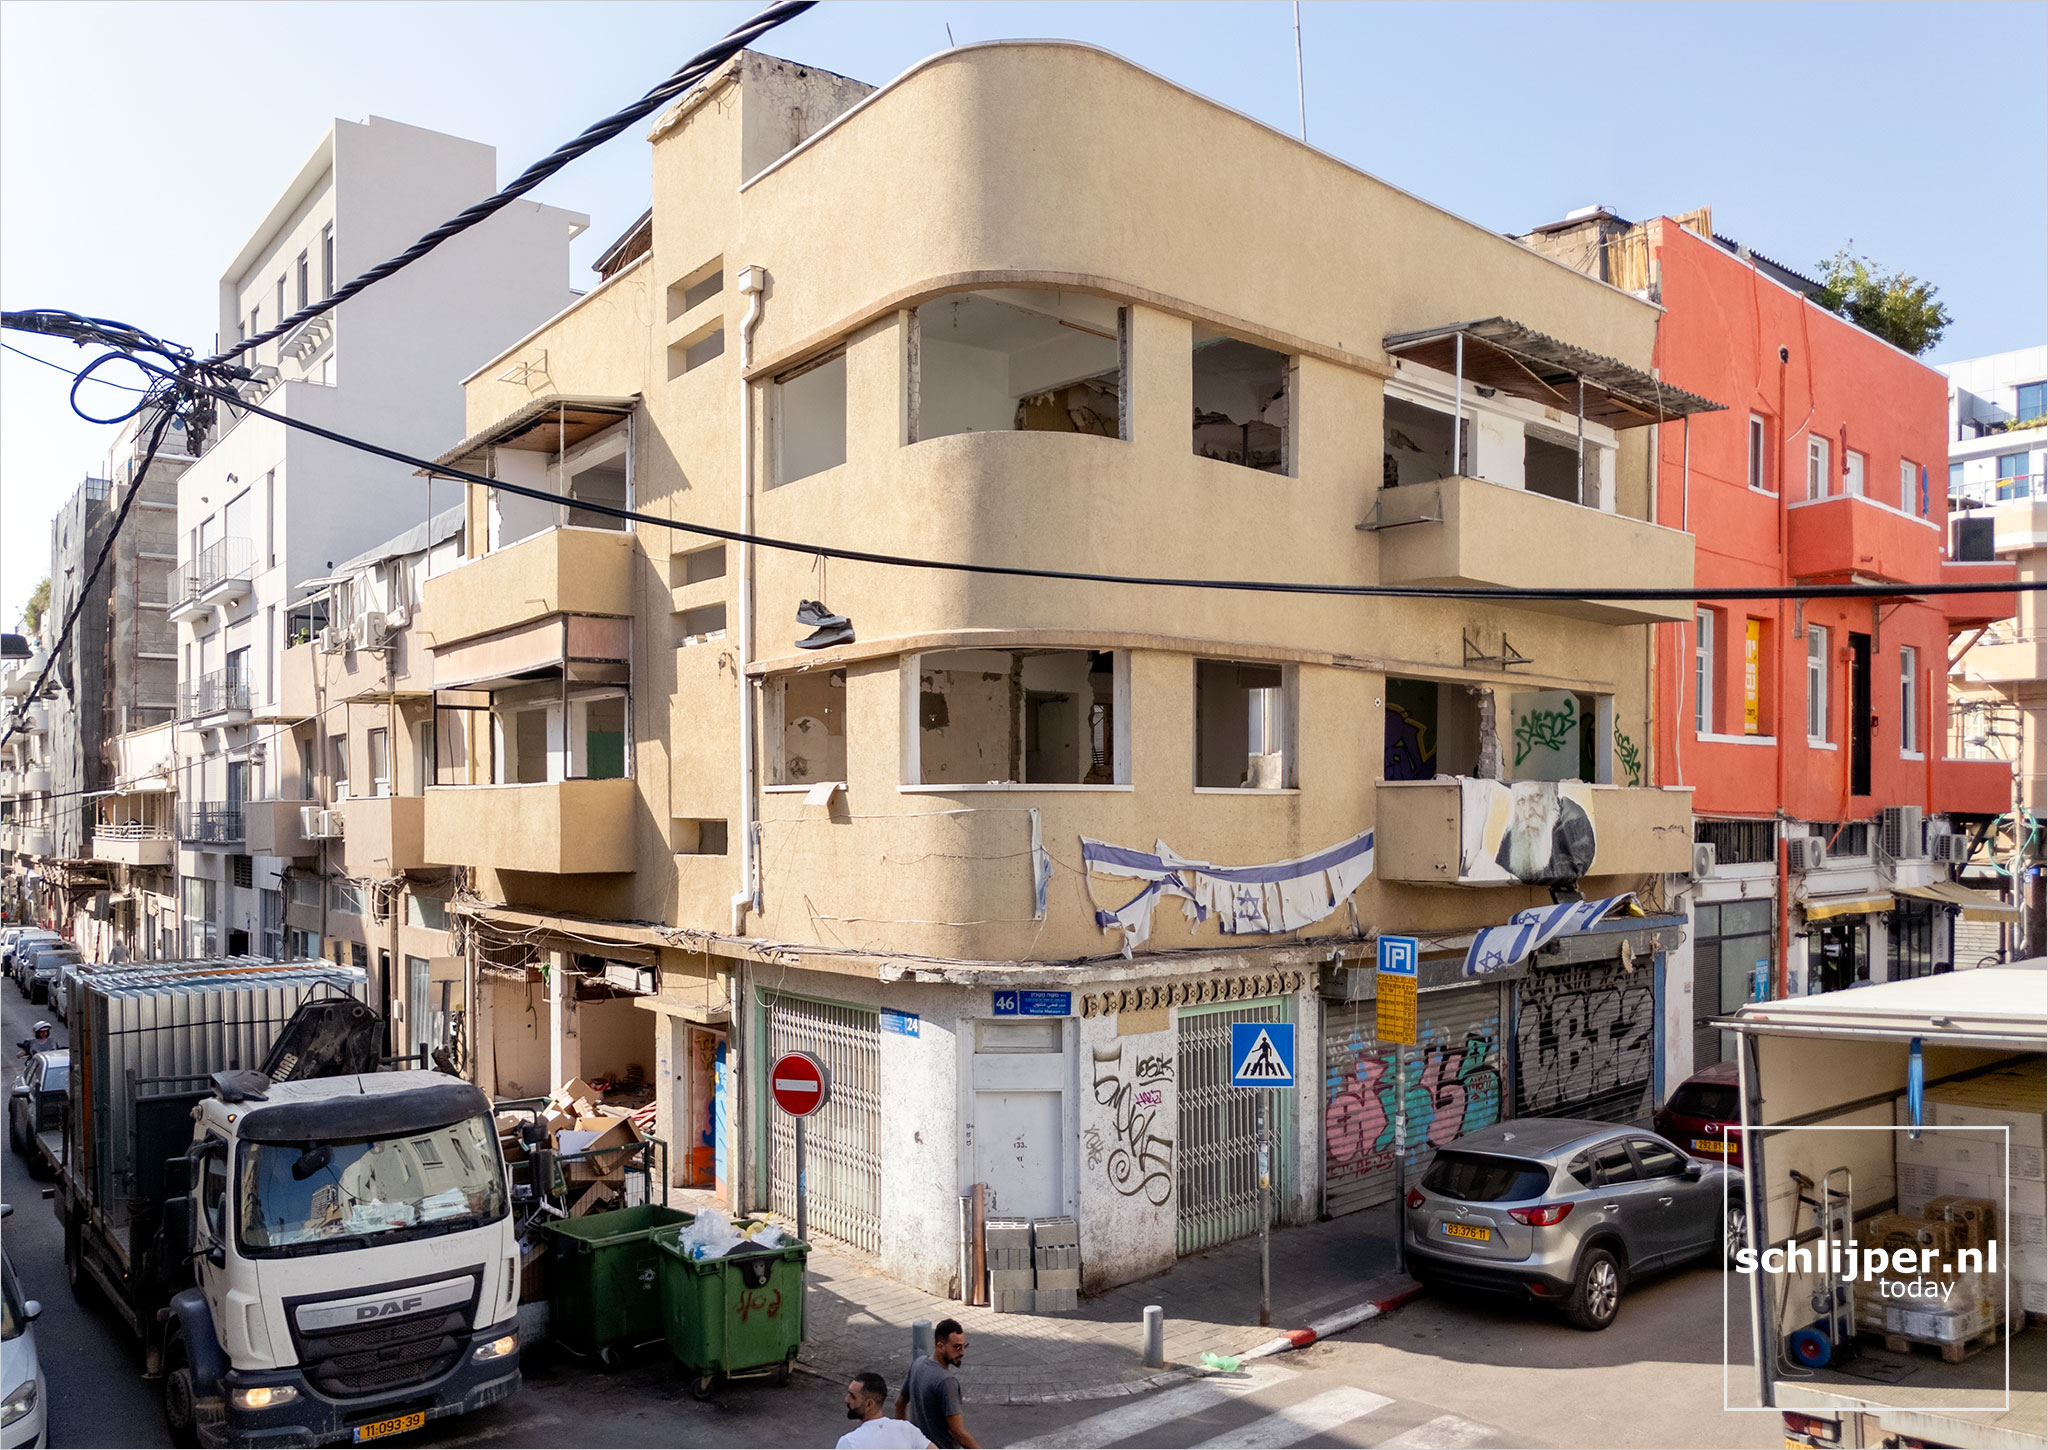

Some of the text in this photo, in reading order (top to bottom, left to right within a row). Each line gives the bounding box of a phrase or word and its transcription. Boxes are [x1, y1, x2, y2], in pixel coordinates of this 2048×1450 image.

[996, 996, 1015, 1010] 46
[907, 1017, 918, 1033] 24
[272, 1052, 299, 1082] HIAB
[356, 1297, 422, 1320] DAF
